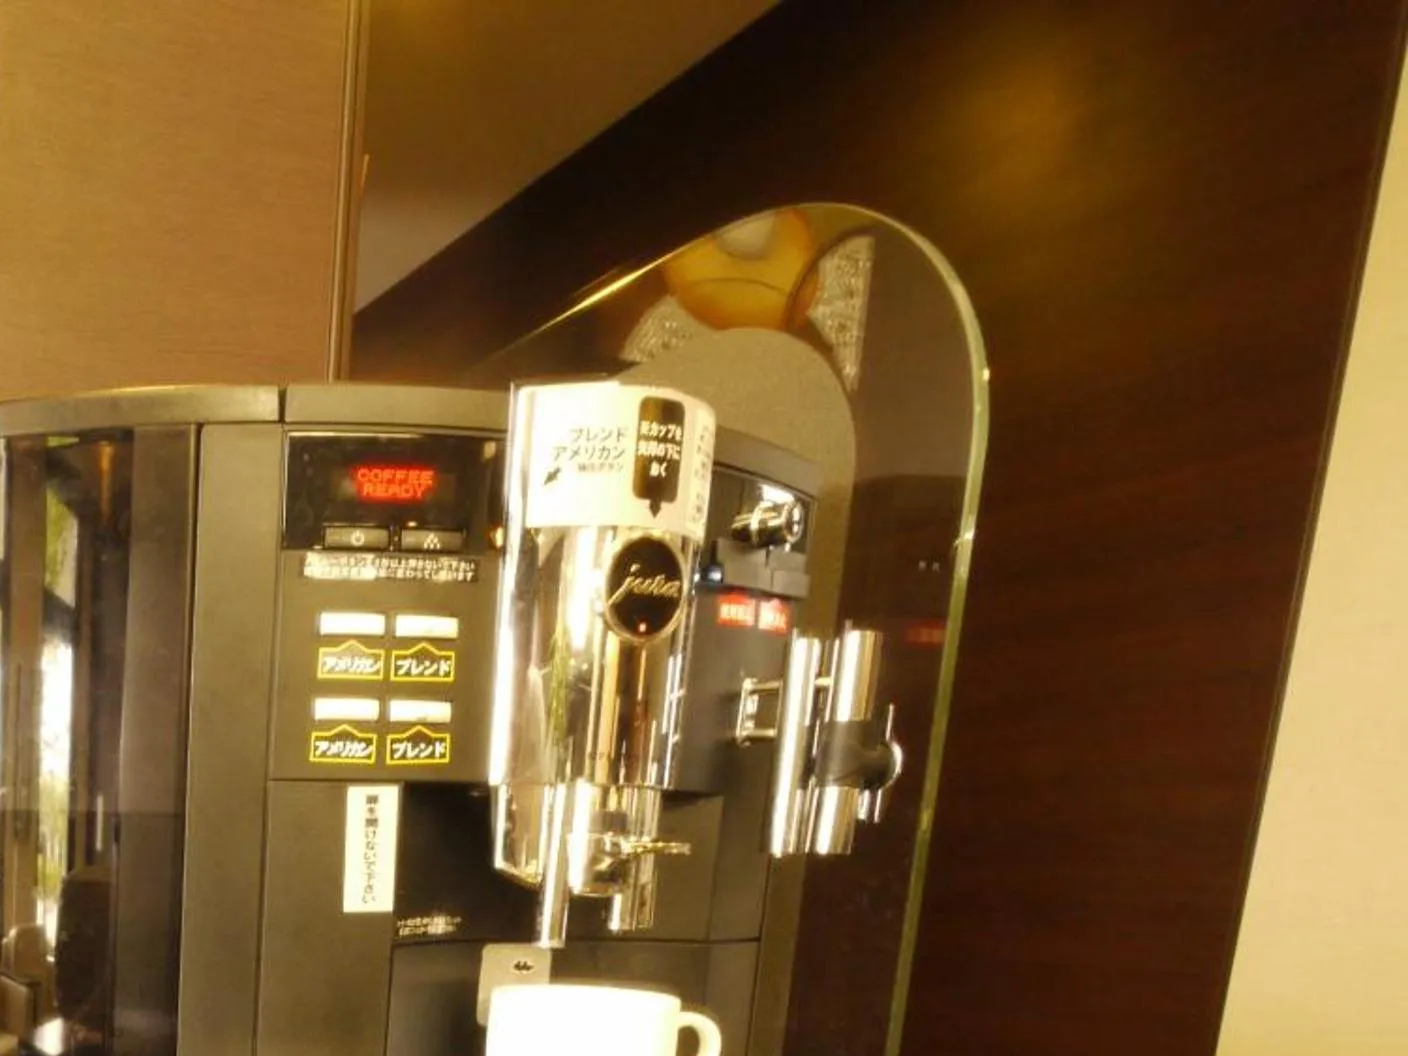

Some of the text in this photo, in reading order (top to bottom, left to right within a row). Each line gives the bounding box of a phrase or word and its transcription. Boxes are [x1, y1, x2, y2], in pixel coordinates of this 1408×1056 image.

[570, 427, 629, 442] ブレンド
[554, 445, 626, 461] アメリカン
[357, 468, 435, 484] COFFEE
[363, 483, 426, 497] READY
[322, 655, 381, 674] アメリカン
[396, 658, 451, 676] ブレンド
[314, 740, 374, 757] アメリカン
[392, 741, 446, 759] ブレンド
